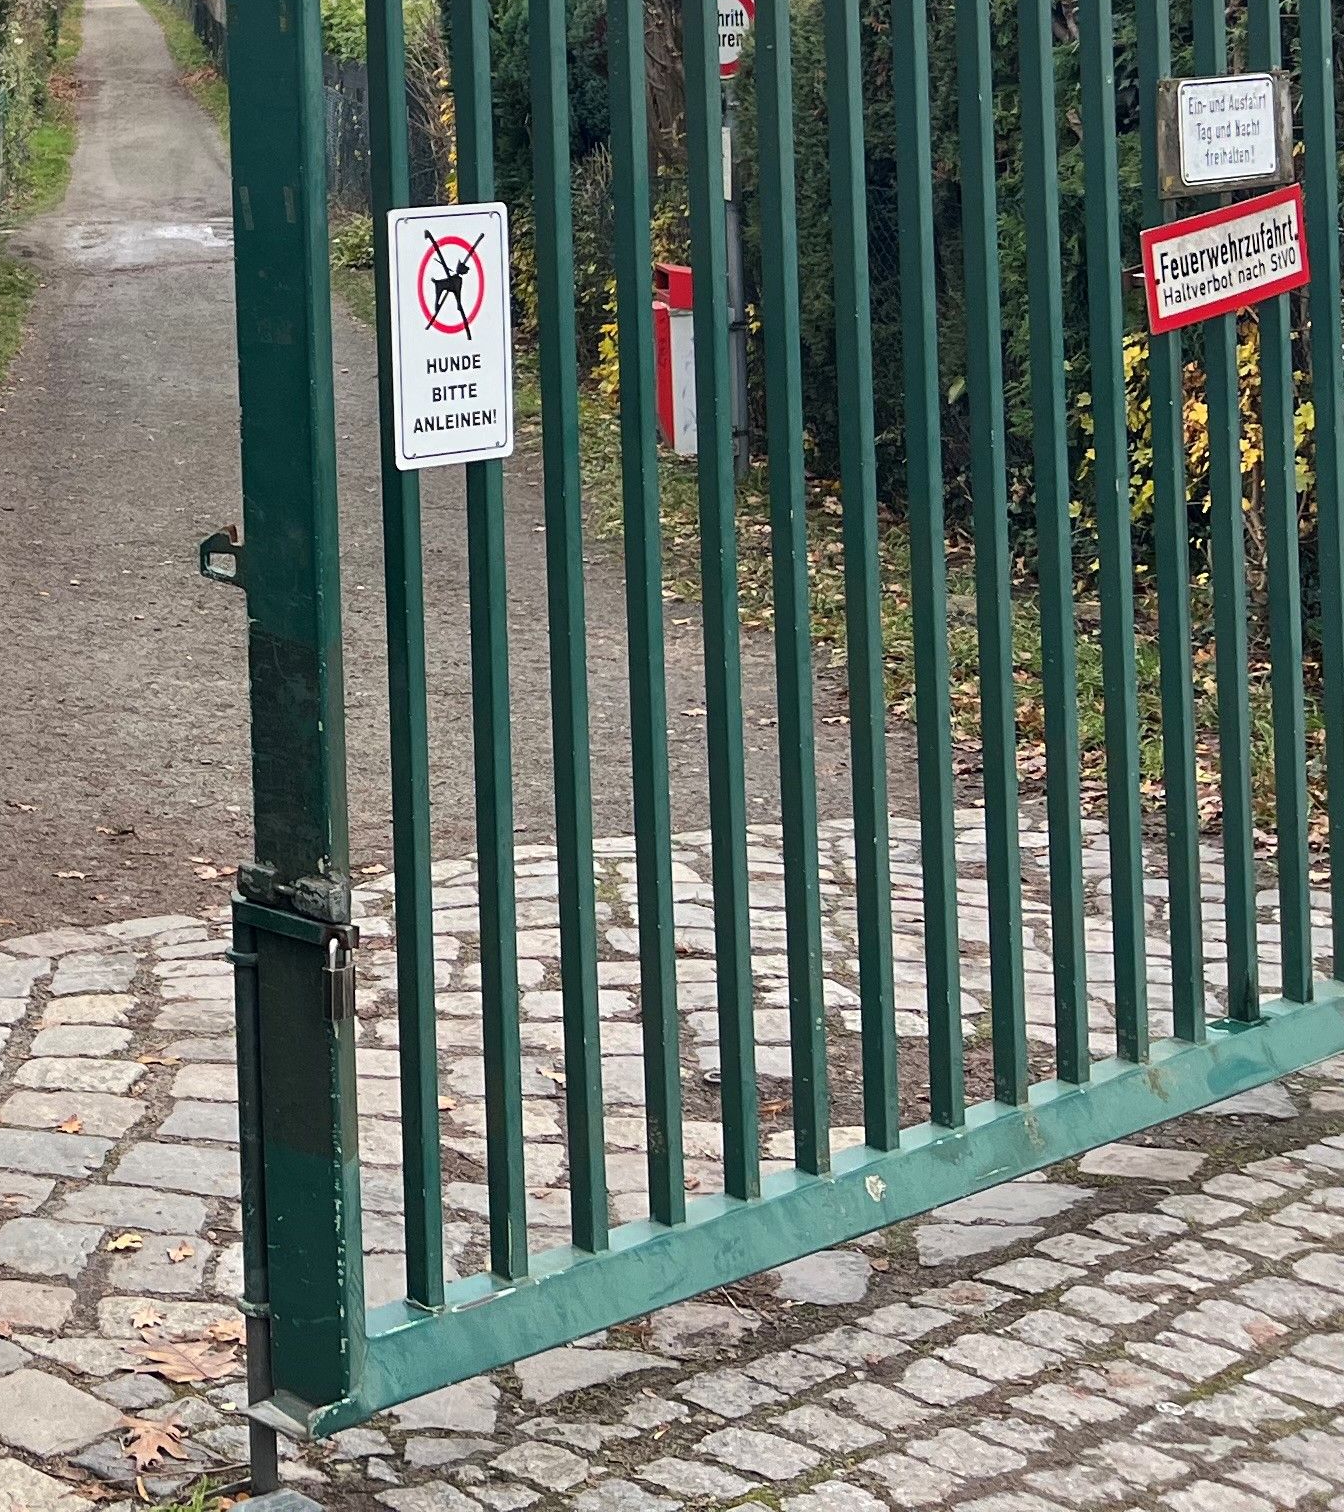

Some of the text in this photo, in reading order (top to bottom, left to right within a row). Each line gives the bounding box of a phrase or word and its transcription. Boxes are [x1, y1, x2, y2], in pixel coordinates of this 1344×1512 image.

[1188, 93, 1267, 115] Ein- und Ausfahrt
[1196, 119, 1260, 145] Tag und Nacht
[1160, 215, 1294, 283] Feuerwehrzufahrt
[1163, 247, 1297, 307] Haltverbot nach StVO
[426, 353, 482, 374] HUNDE
[432, 383, 478, 402] BITTE
[413, 409, 497, 434] ANLEINEN!
